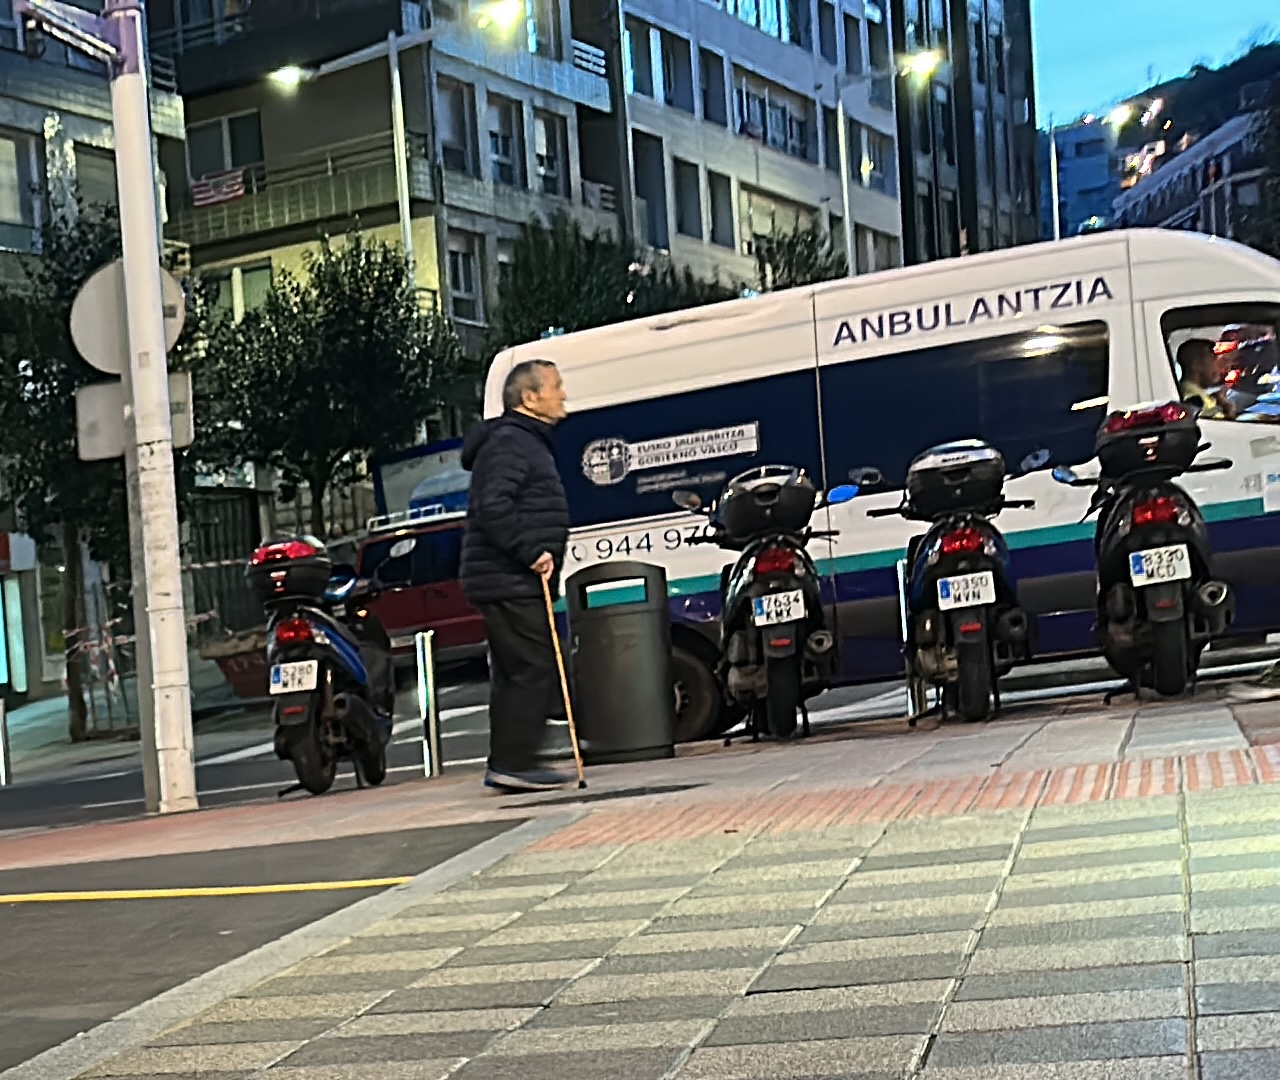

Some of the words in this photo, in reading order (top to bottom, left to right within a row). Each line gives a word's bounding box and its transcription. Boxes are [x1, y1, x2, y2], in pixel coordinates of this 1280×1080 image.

[832, 276, 1113, 347] ANBULANTZIA
[637, 440, 671, 454] EUSKO
[637, 449, 697, 466] GOBIERNO
[701, 440, 738, 455] VASCO
[595, 532, 654, 560] 944
